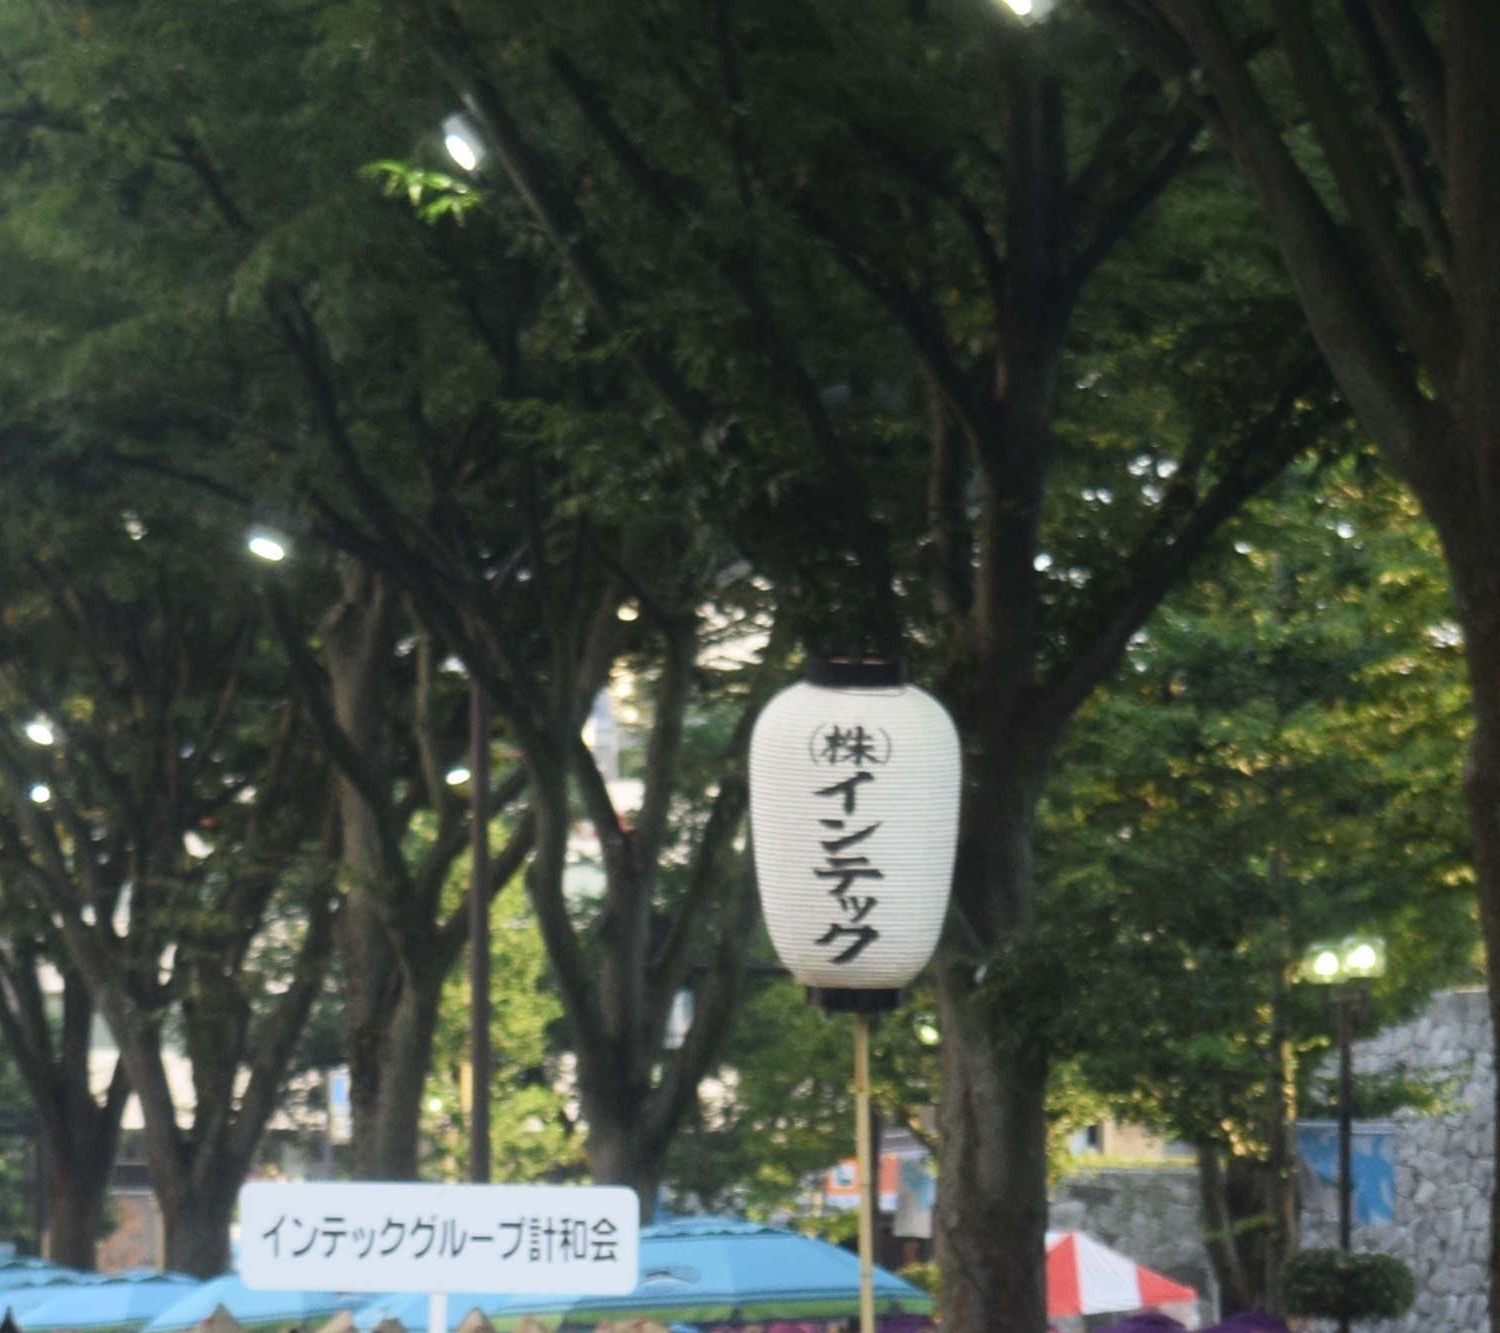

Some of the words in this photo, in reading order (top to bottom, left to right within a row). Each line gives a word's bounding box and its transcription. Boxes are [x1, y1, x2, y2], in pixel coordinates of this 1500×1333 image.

[261, 1212, 619, 1265] インテックグループ計和会
